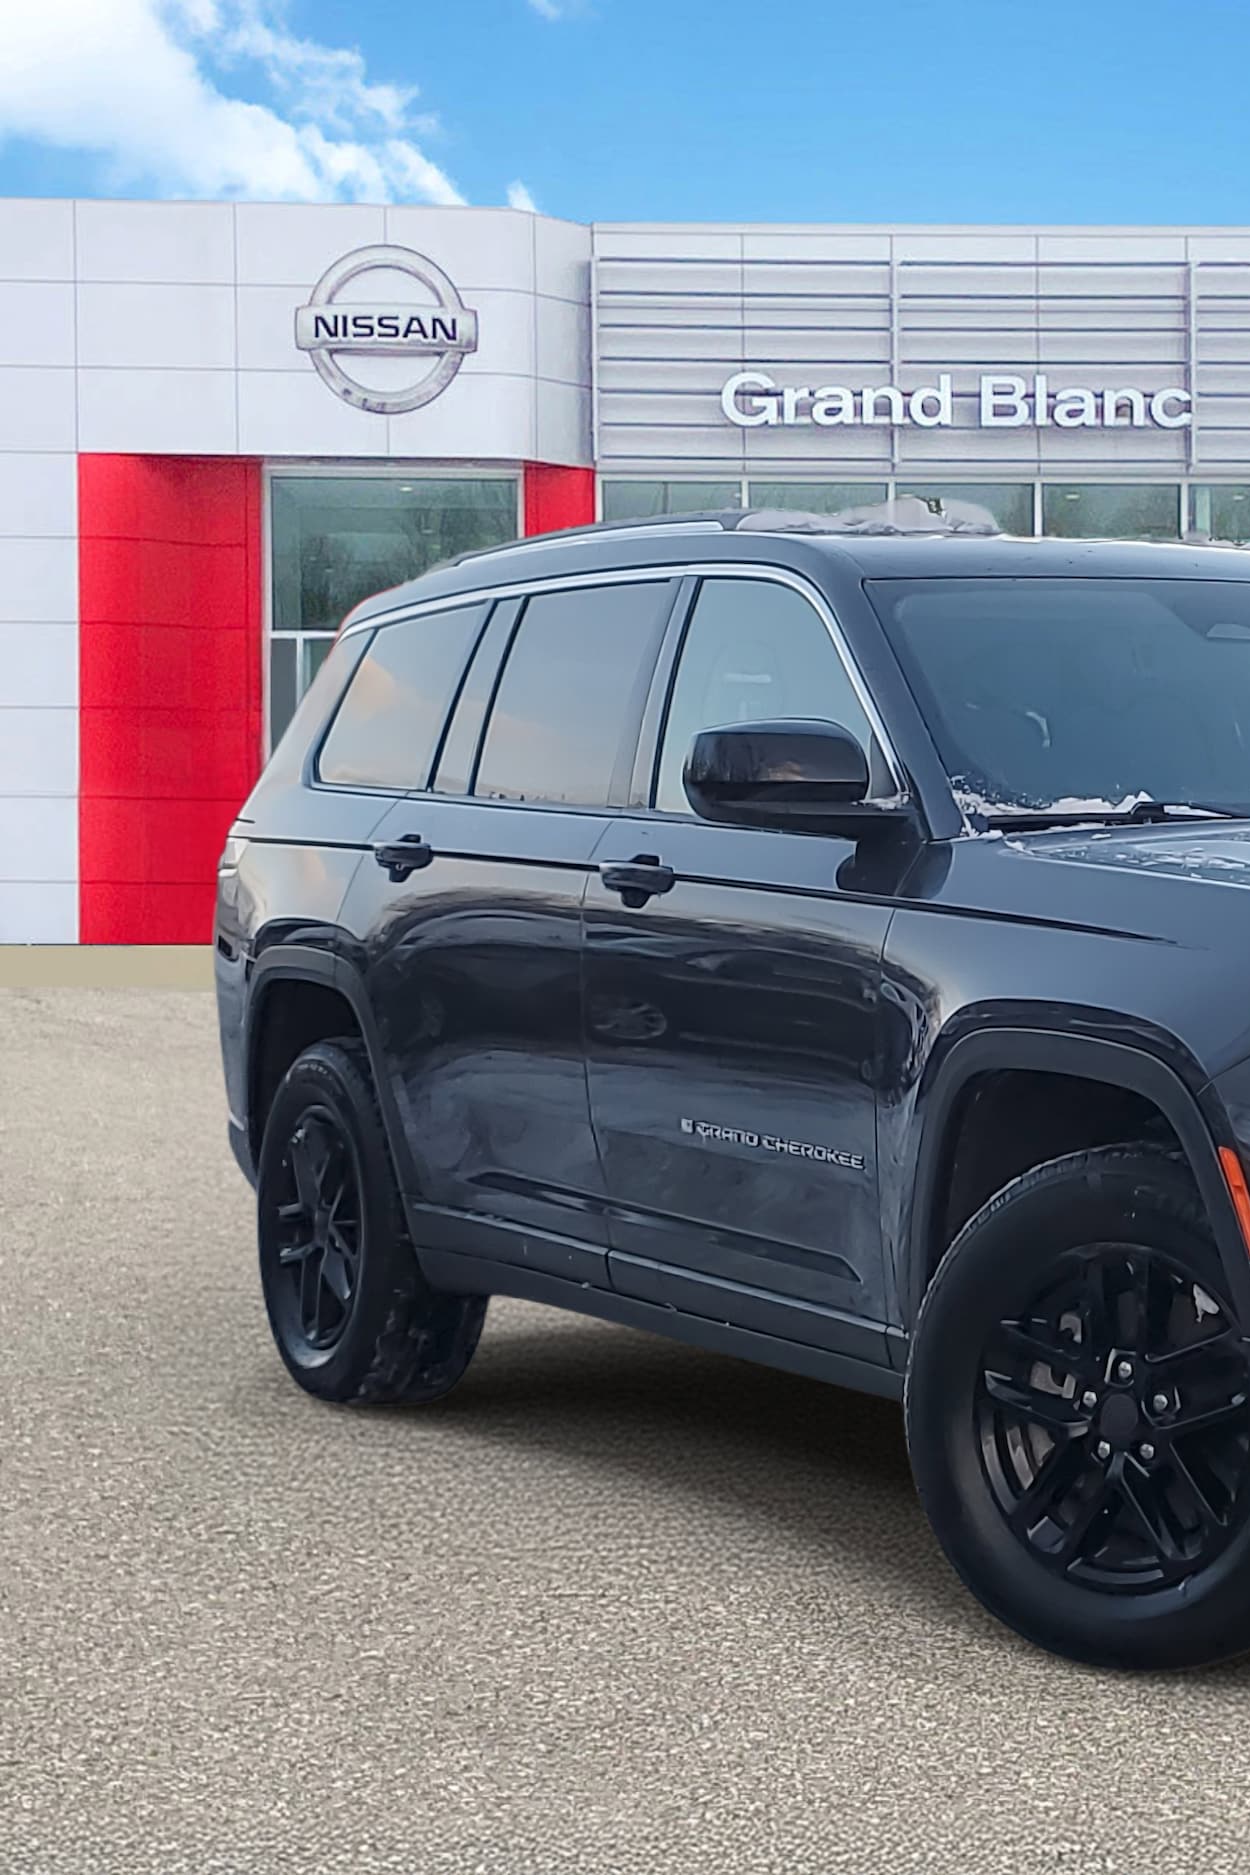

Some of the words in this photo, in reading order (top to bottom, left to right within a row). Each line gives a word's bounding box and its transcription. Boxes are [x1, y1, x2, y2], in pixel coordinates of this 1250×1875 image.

[314, 315, 457, 341] NISSAN
[720, 371, 951, 428] Grand
[979, 373, 1193, 428] Blanc
[696, 1121, 759, 1147] GRAND
[762, 1135, 865, 1169] CHEROKEE
